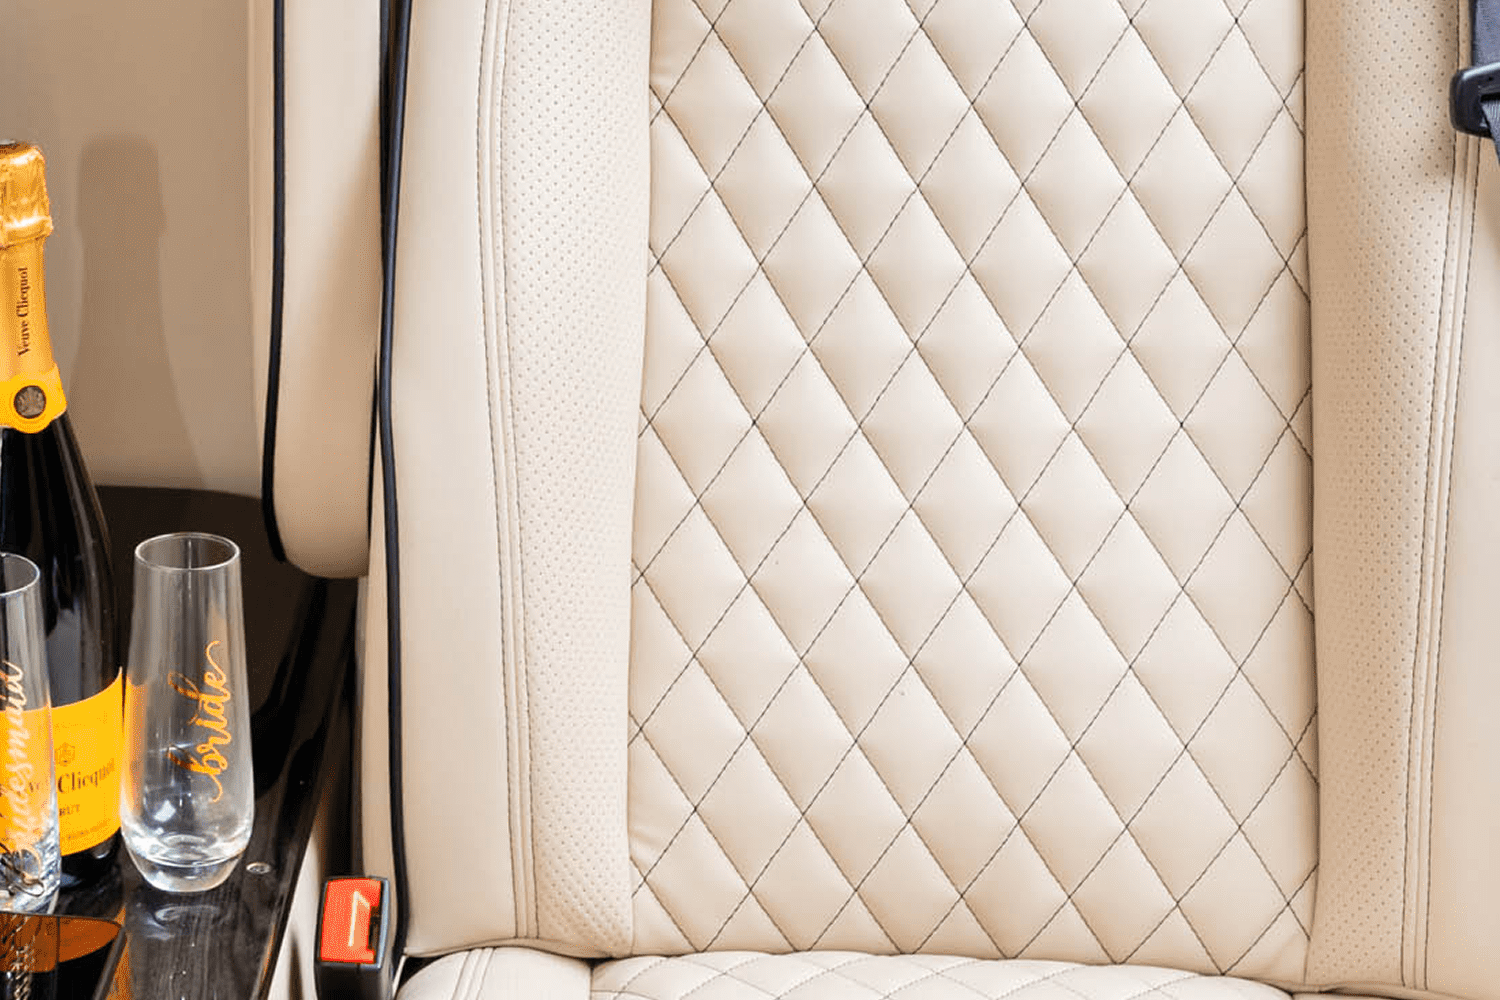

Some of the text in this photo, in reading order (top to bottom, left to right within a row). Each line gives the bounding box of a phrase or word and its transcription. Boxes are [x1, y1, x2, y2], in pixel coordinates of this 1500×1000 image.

[16, 267, 31, 356] Veuve Clicquot
[167, 640, 232, 802] bride
[58, 804, 80, 815] RUT
